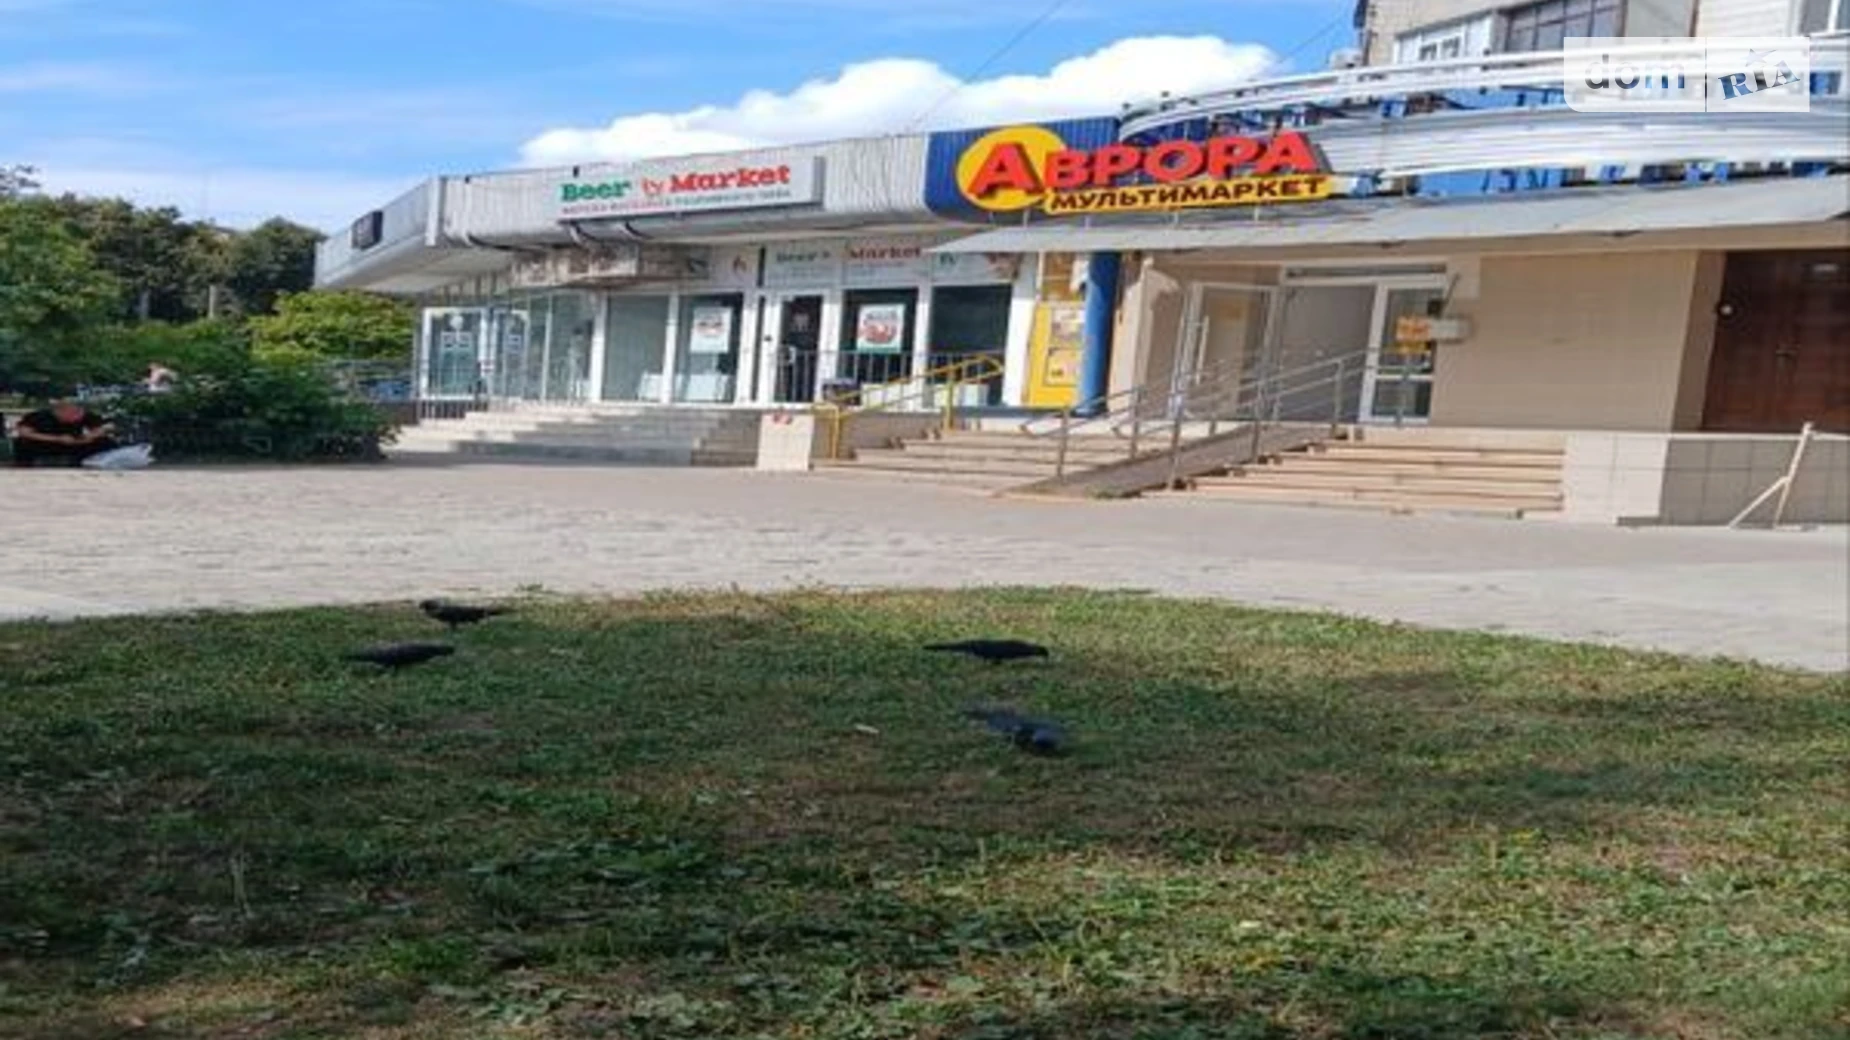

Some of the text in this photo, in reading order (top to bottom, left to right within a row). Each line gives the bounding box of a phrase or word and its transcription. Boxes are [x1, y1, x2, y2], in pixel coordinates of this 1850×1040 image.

[561, 179, 631, 201] Beer
[670, 164, 791, 193] Market
[967, 130, 1322, 199] АВРОРА
[1050, 177, 1327, 210] МУЛЬТИМАРКЕТ
